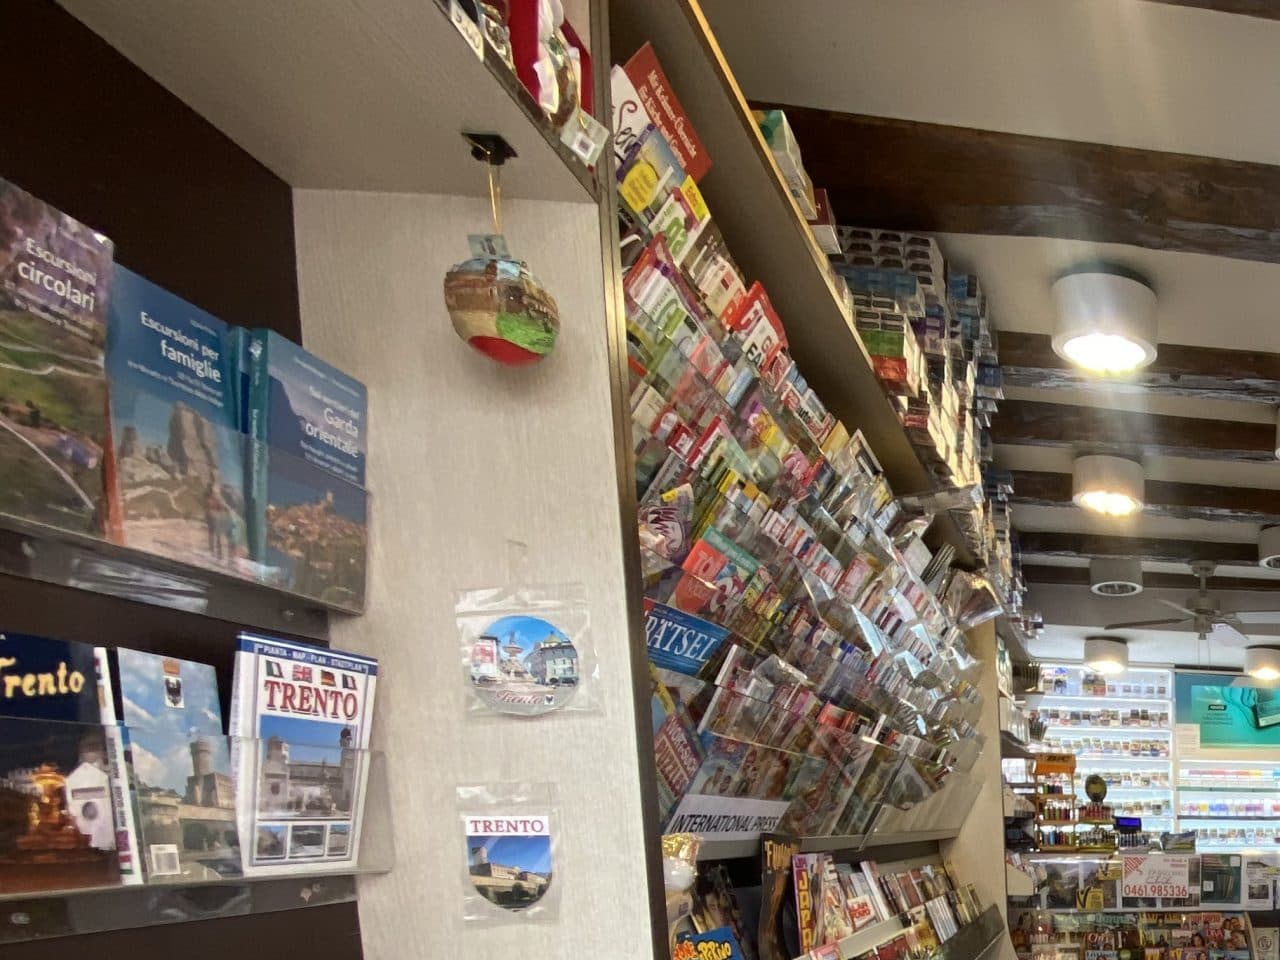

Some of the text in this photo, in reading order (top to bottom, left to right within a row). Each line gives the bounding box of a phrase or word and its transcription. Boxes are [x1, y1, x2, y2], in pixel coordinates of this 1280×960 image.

[26, 237, 97, 286] Escursioni
[17, 261, 95, 312] circolari
[140, 311, 219, 361] Escursioni per
[161, 340, 221, 383] famiglie
[305, 423, 359, 458] orientale
[323, 408, 359, 437] Garda
[264, 679, 359, 721] TRENTO
[470, 820, 544, 834] TRENTO
[671, 814, 780, 832] INTERNATIONAL PRESS
[1124, 884, 1187, 897] 0461.985336
